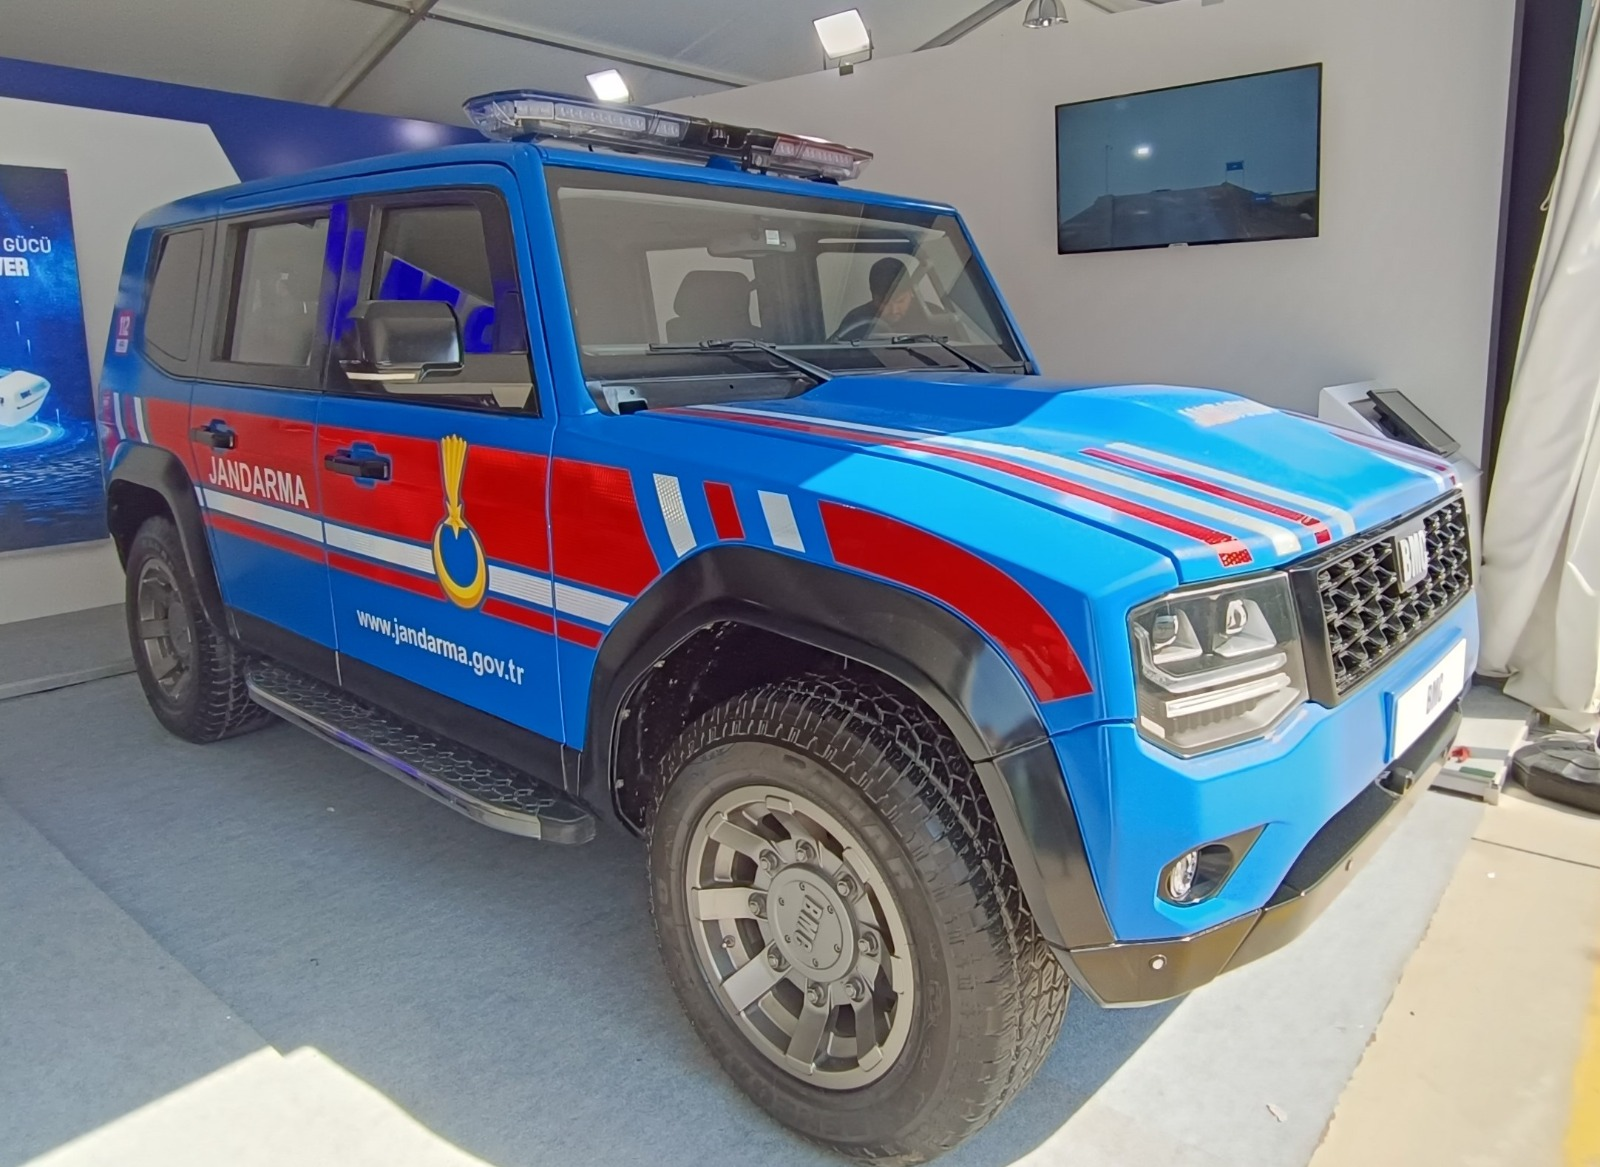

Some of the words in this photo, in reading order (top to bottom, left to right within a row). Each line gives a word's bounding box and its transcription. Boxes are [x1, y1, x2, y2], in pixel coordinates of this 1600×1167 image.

[0, 256, 30, 277] ER
[3, 235, 52, 253] GÜCÜ
[208, 456, 310, 509] JANDARMA
[356, 609, 525, 686] www.jandarma.gov.tr
[1426, 672, 1444, 715] BMC
[793, 894, 824, 953] BMC
